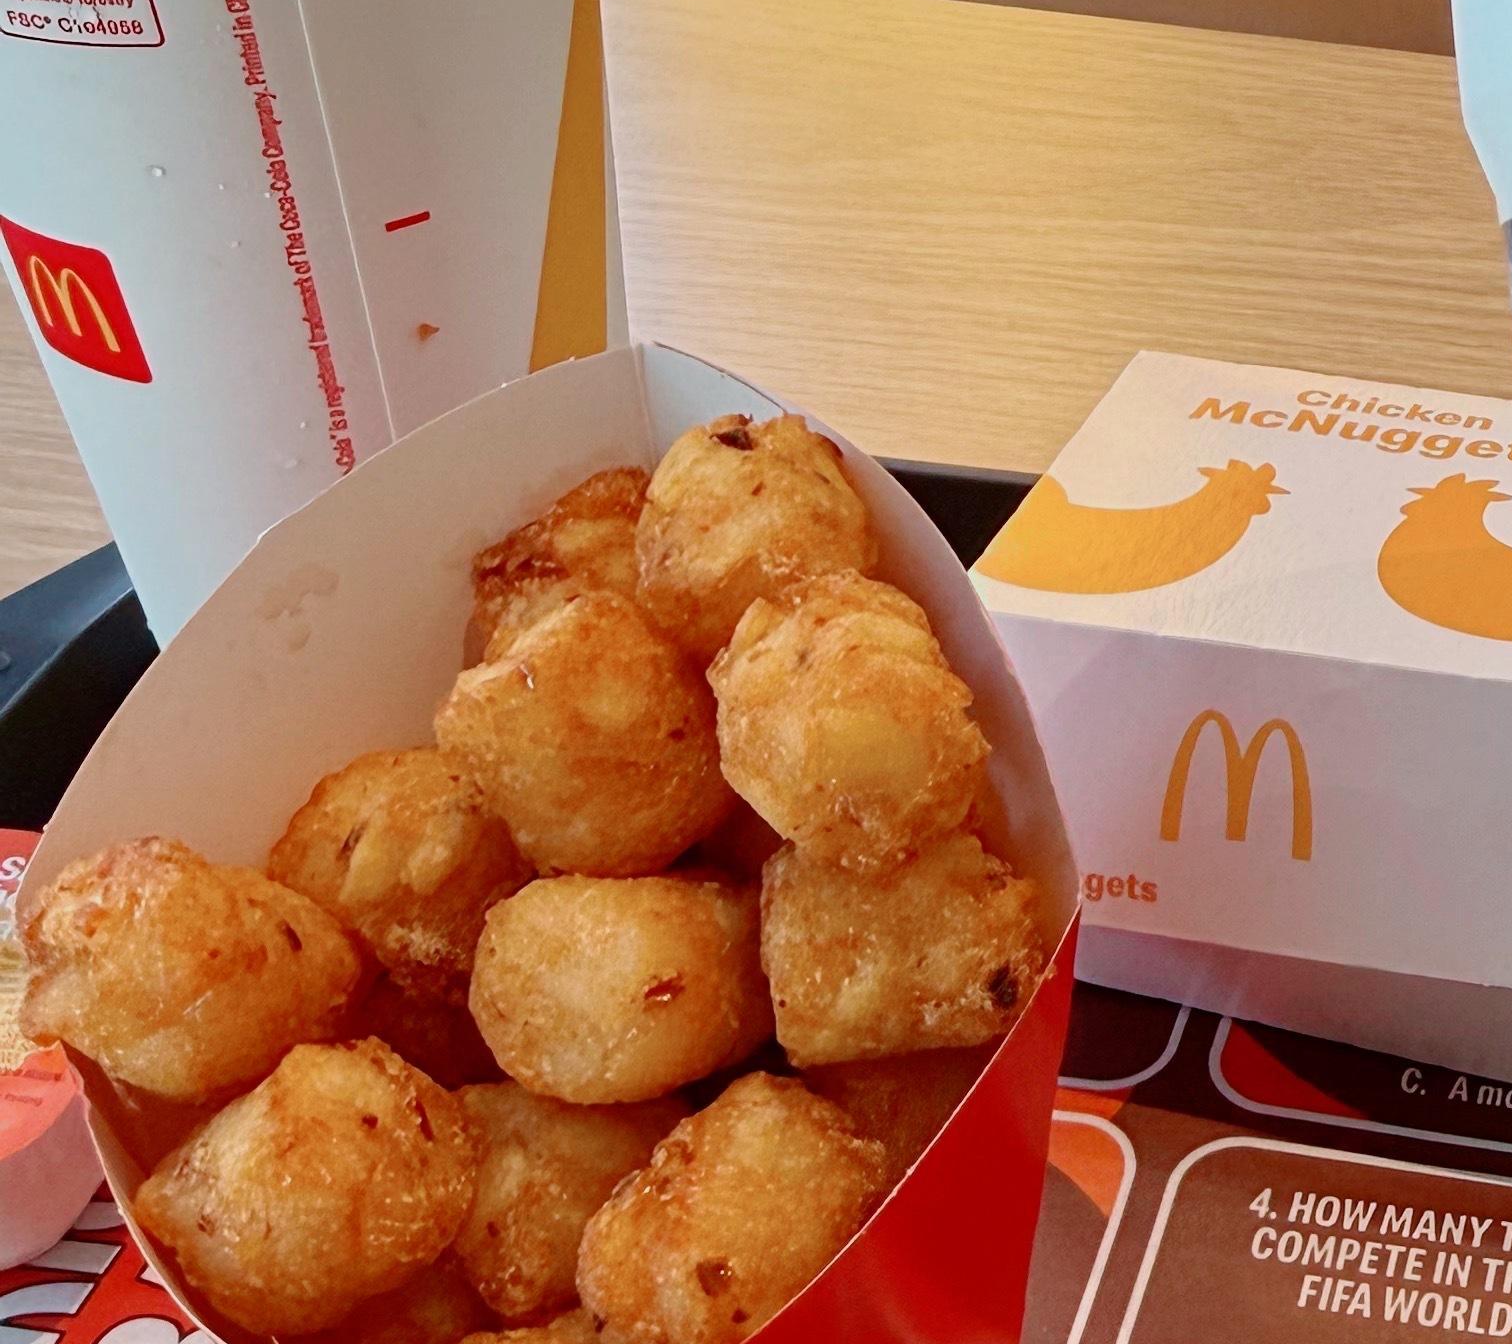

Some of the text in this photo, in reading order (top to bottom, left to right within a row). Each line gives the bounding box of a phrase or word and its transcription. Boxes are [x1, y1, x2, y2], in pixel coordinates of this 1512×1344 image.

[1296, 390, 1494, 431] Chicken
[1084, 873, 1158, 903] gets
[1401, 1067, 1426, 1096] C.
[1448, 1074, 1471, 1102] A
[1249, 1187, 1277, 1220] 4.
[1288, 1191, 1377, 1233] HOW
[1378, 1204, 1492, 1249] MANY
[1250, 1225, 1427, 1283] COMPETE
[1433, 1251, 1470, 1288] IN
[1297, 1274, 1373, 1320] FIFA
